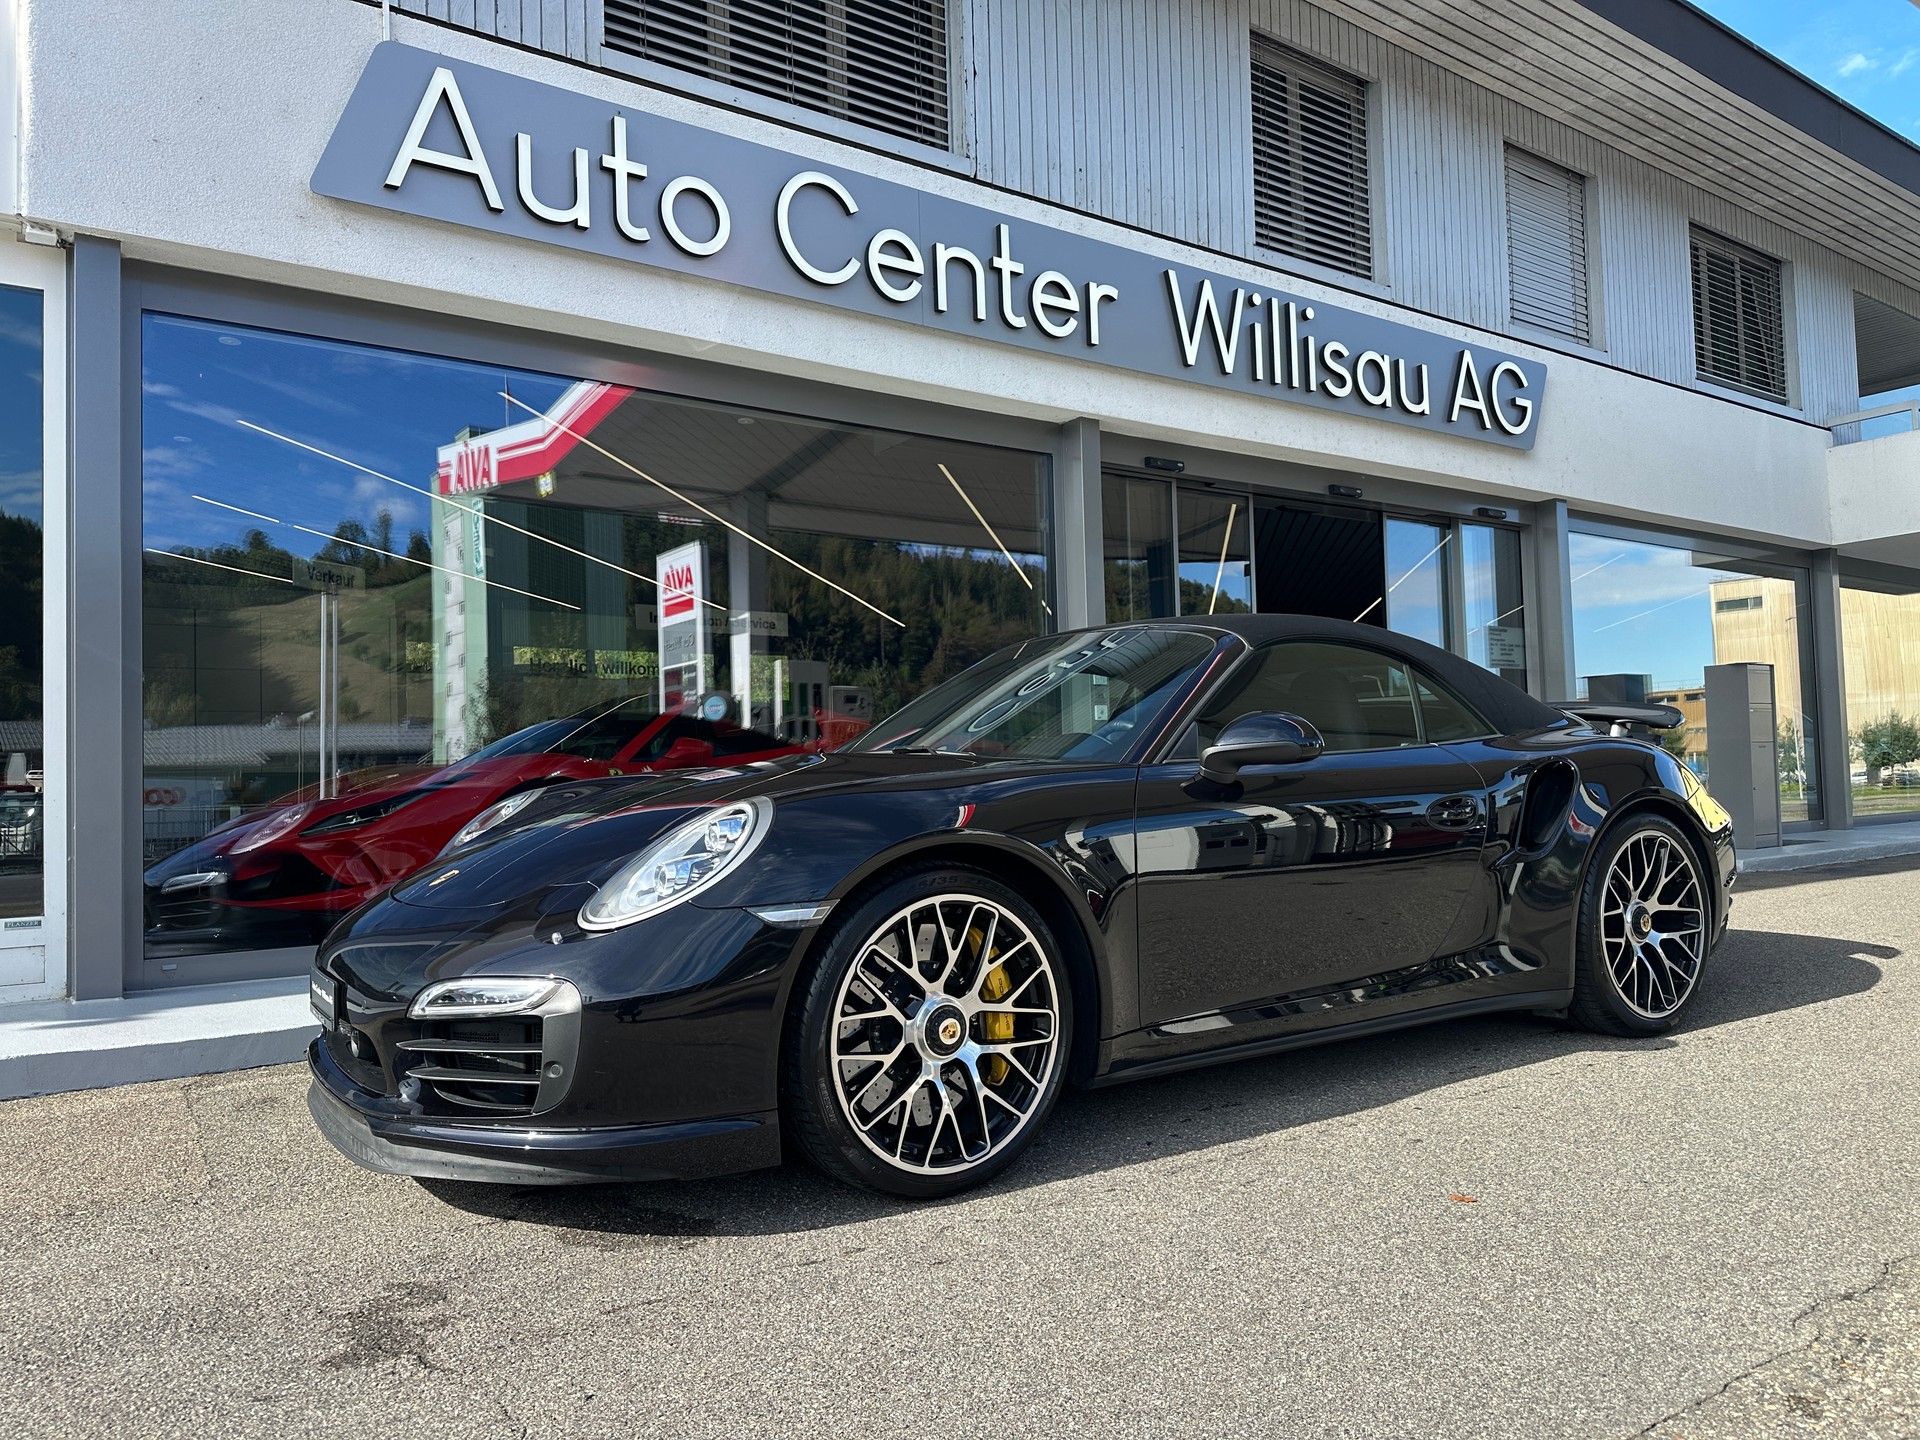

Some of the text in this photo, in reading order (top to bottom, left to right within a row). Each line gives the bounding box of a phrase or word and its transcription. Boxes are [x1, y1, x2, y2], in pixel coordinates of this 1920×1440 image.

[384, 66, 1533, 436] Auto Center Willisau AG
[307, 565, 356, 588] Verkauf
[602, 660, 660, 676] willkom
[998, 978, 1011, 1031] POHE
